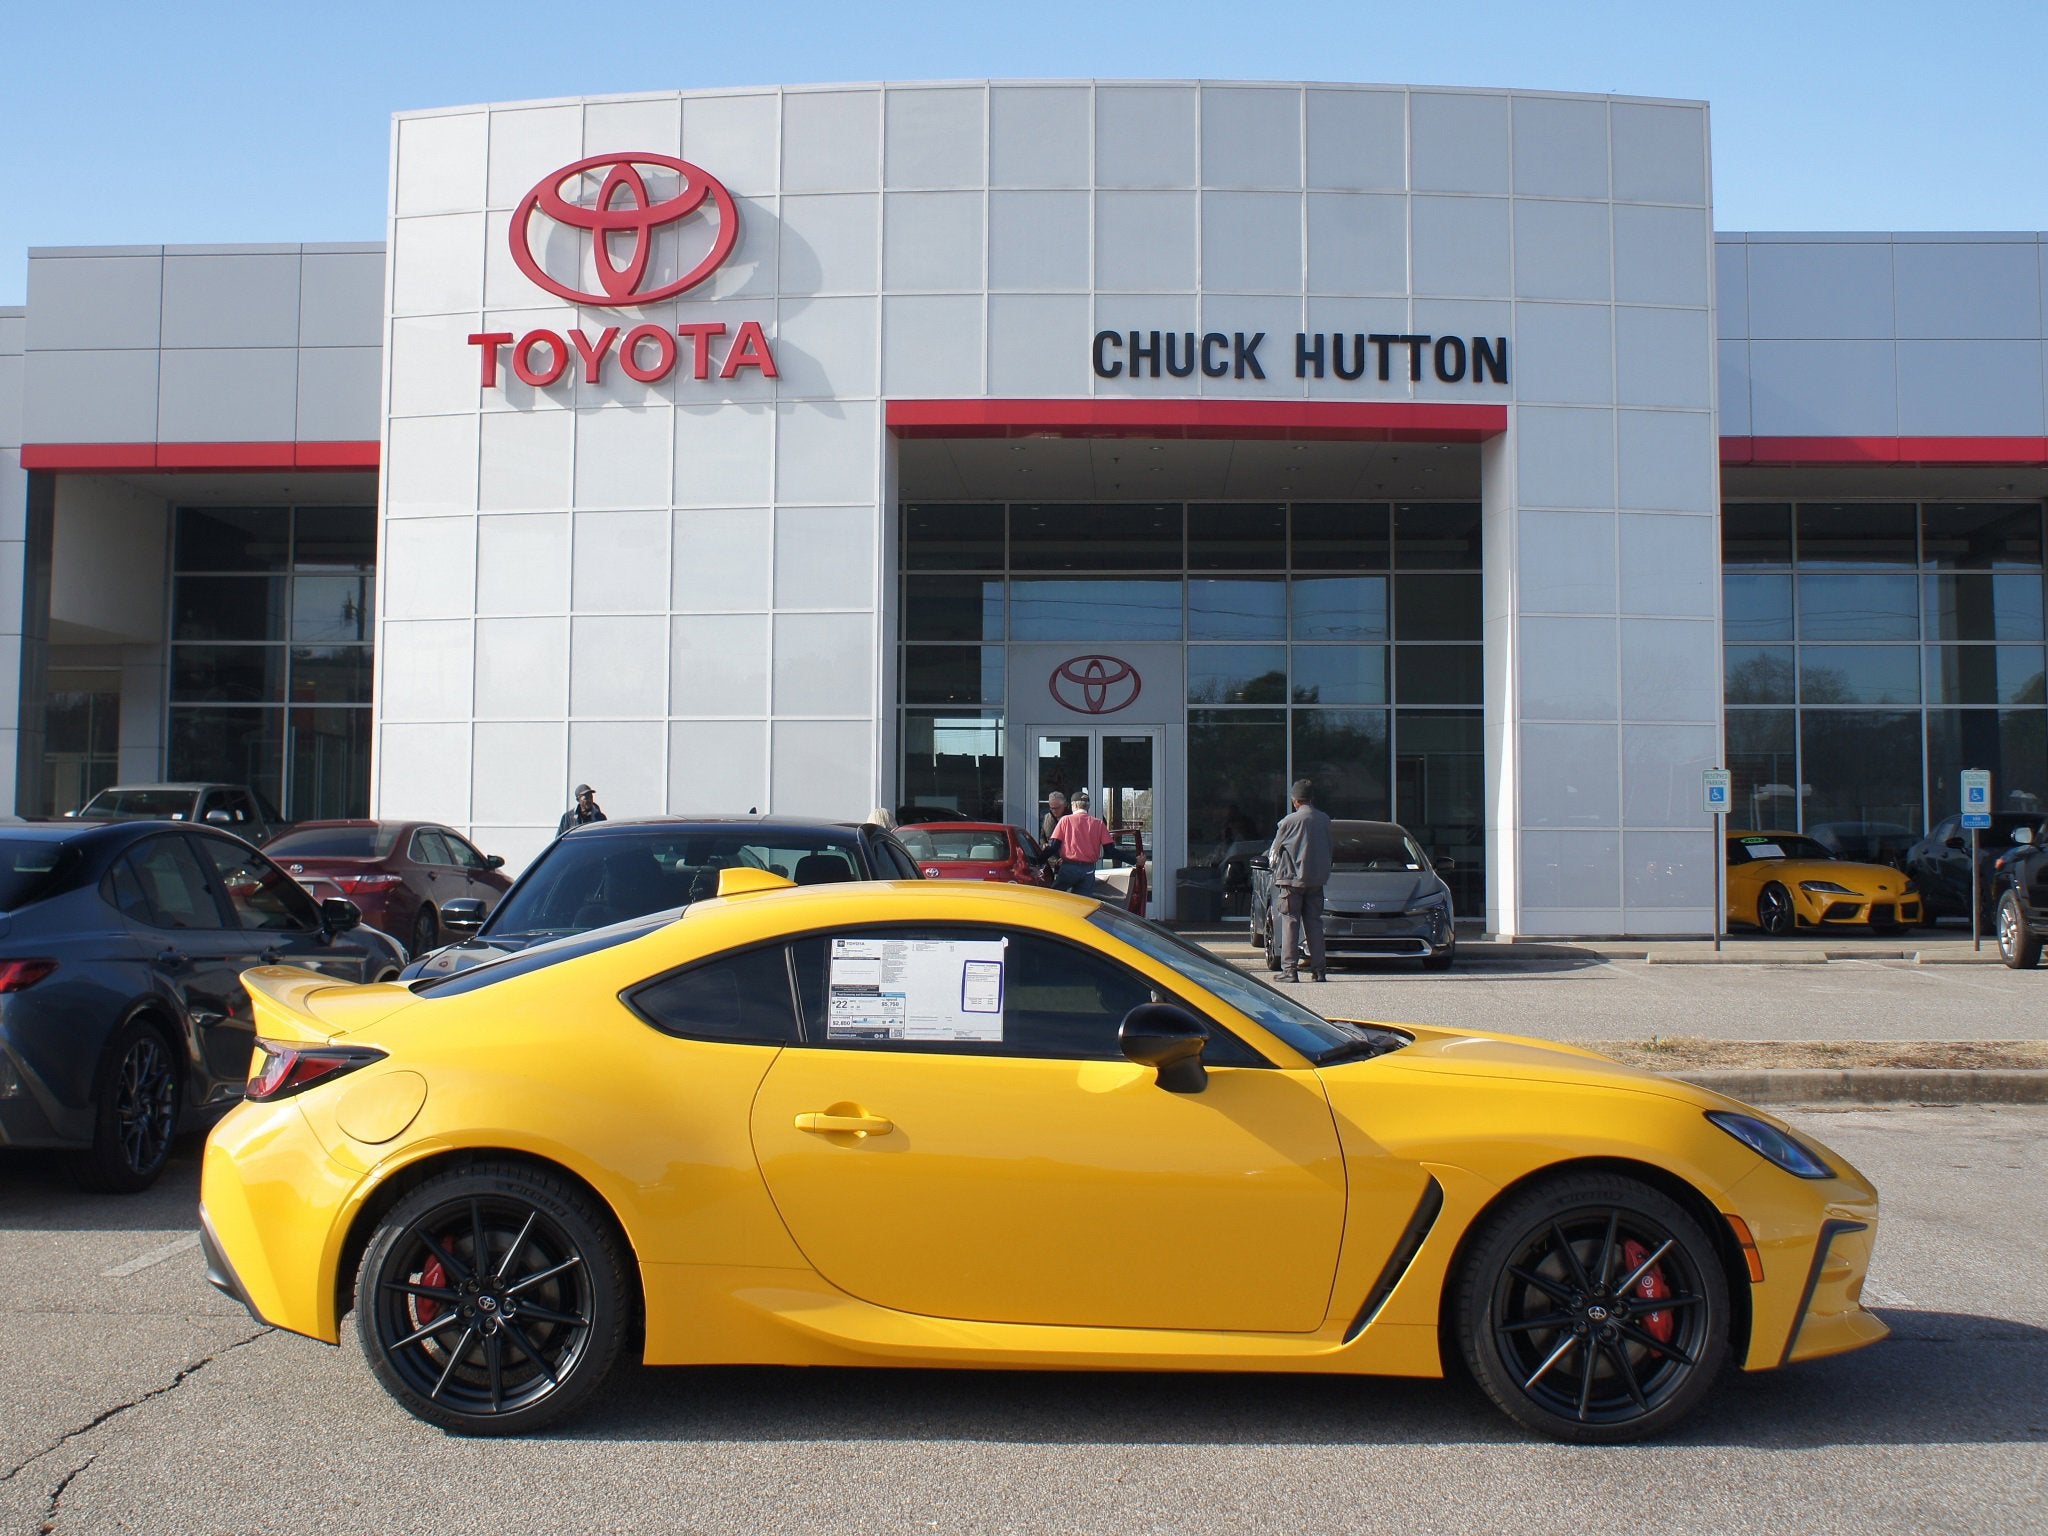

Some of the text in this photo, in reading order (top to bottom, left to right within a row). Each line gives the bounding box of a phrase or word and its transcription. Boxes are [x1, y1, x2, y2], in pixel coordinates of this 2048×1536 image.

[468, 321, 779, 388] TOYOTA
[1092, 330, 1508, 385] CHUCK HUTTON
[835, 1000, 848, 1009] 22
